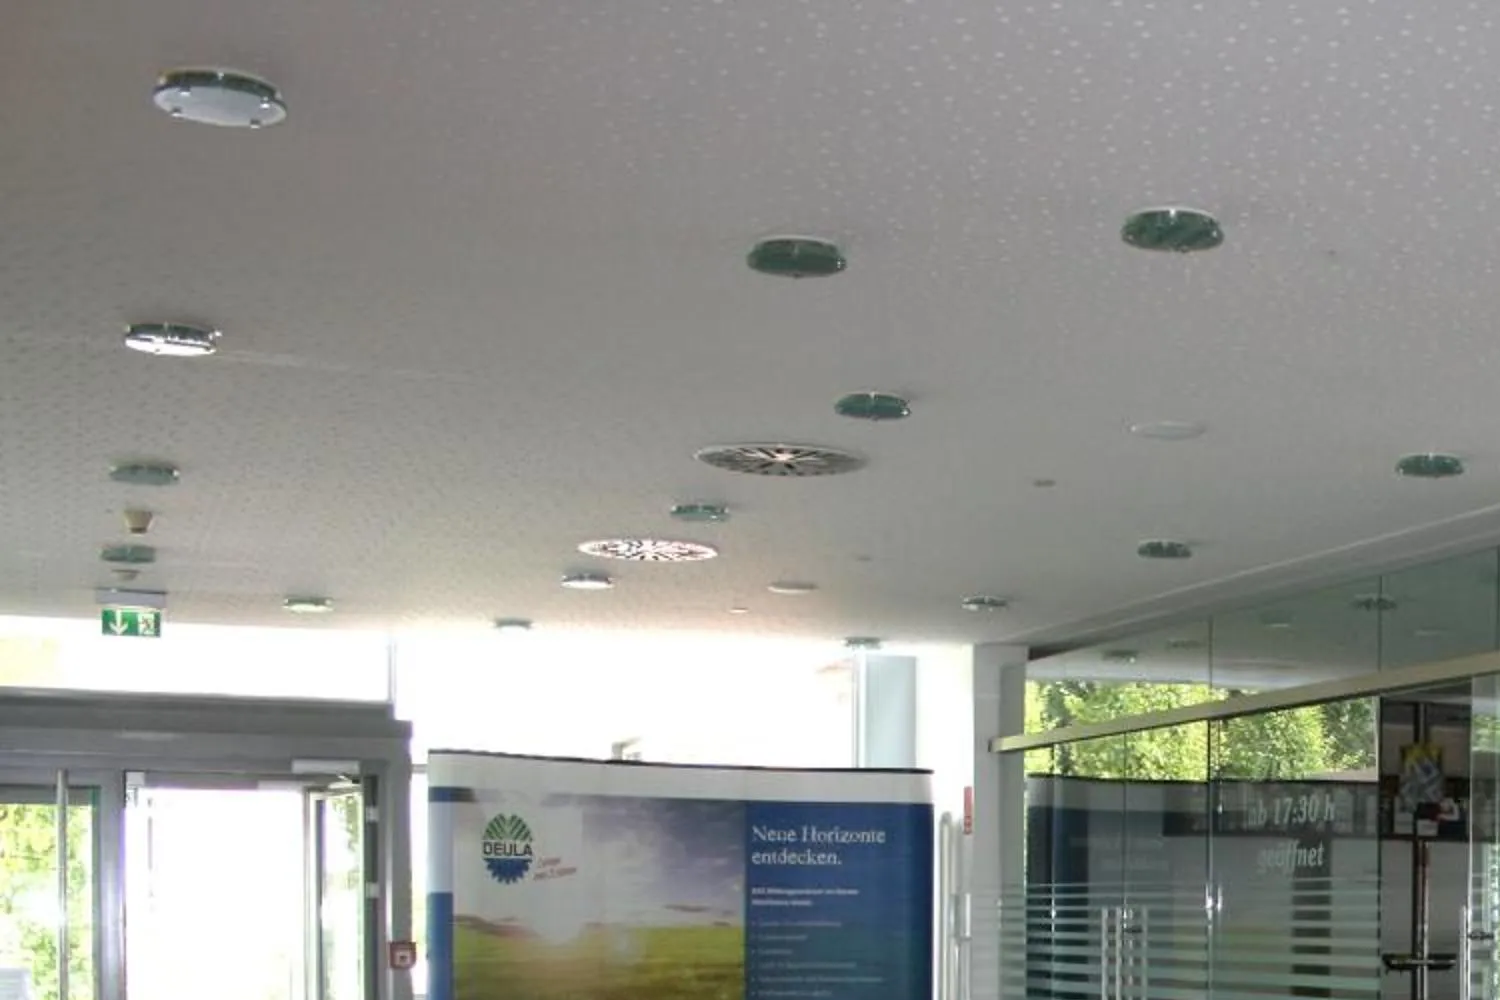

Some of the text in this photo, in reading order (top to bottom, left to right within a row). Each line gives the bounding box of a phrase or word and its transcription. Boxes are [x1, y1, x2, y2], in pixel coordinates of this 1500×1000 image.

[1273, 794, 1320, 825] 17:30
[1323, 793, 1336, 821] h
[752, 825, 886, 844] Neue Horizonte
[483, 841, 533, 857] DEULA
[751, 848, 842, 866] entdecken.
